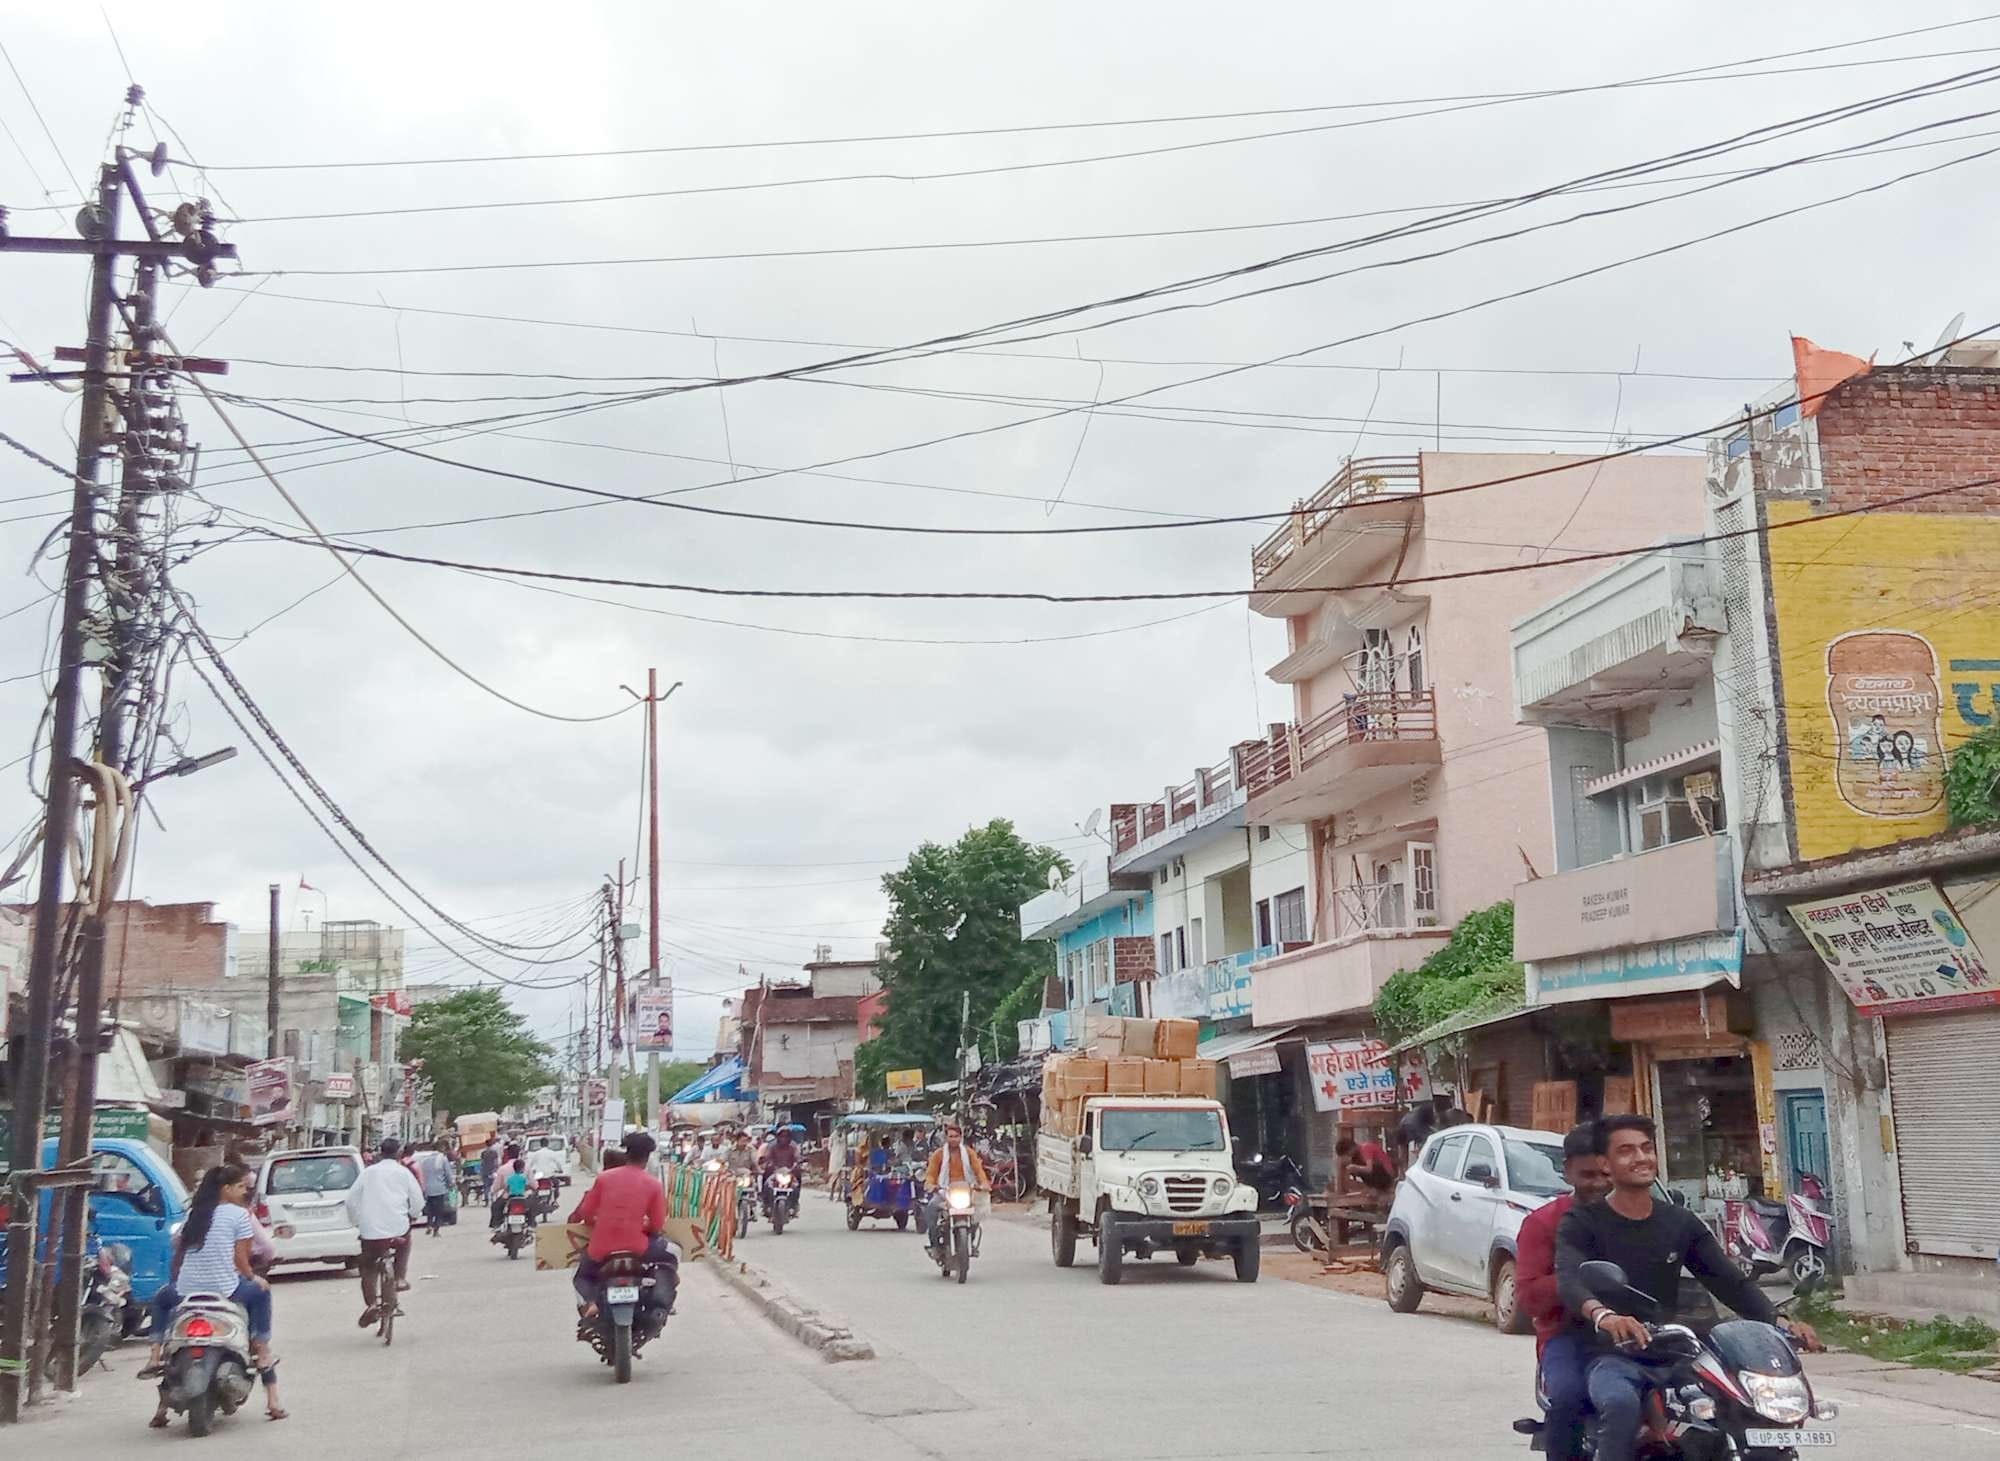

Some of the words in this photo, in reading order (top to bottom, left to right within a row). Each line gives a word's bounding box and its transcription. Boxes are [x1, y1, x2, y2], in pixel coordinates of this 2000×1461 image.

[1606, 888, 1628, 902] KUMAR
[1608, 903, 1630, 918] KUMAR
[329, 1080, 351, 1091] ATM
